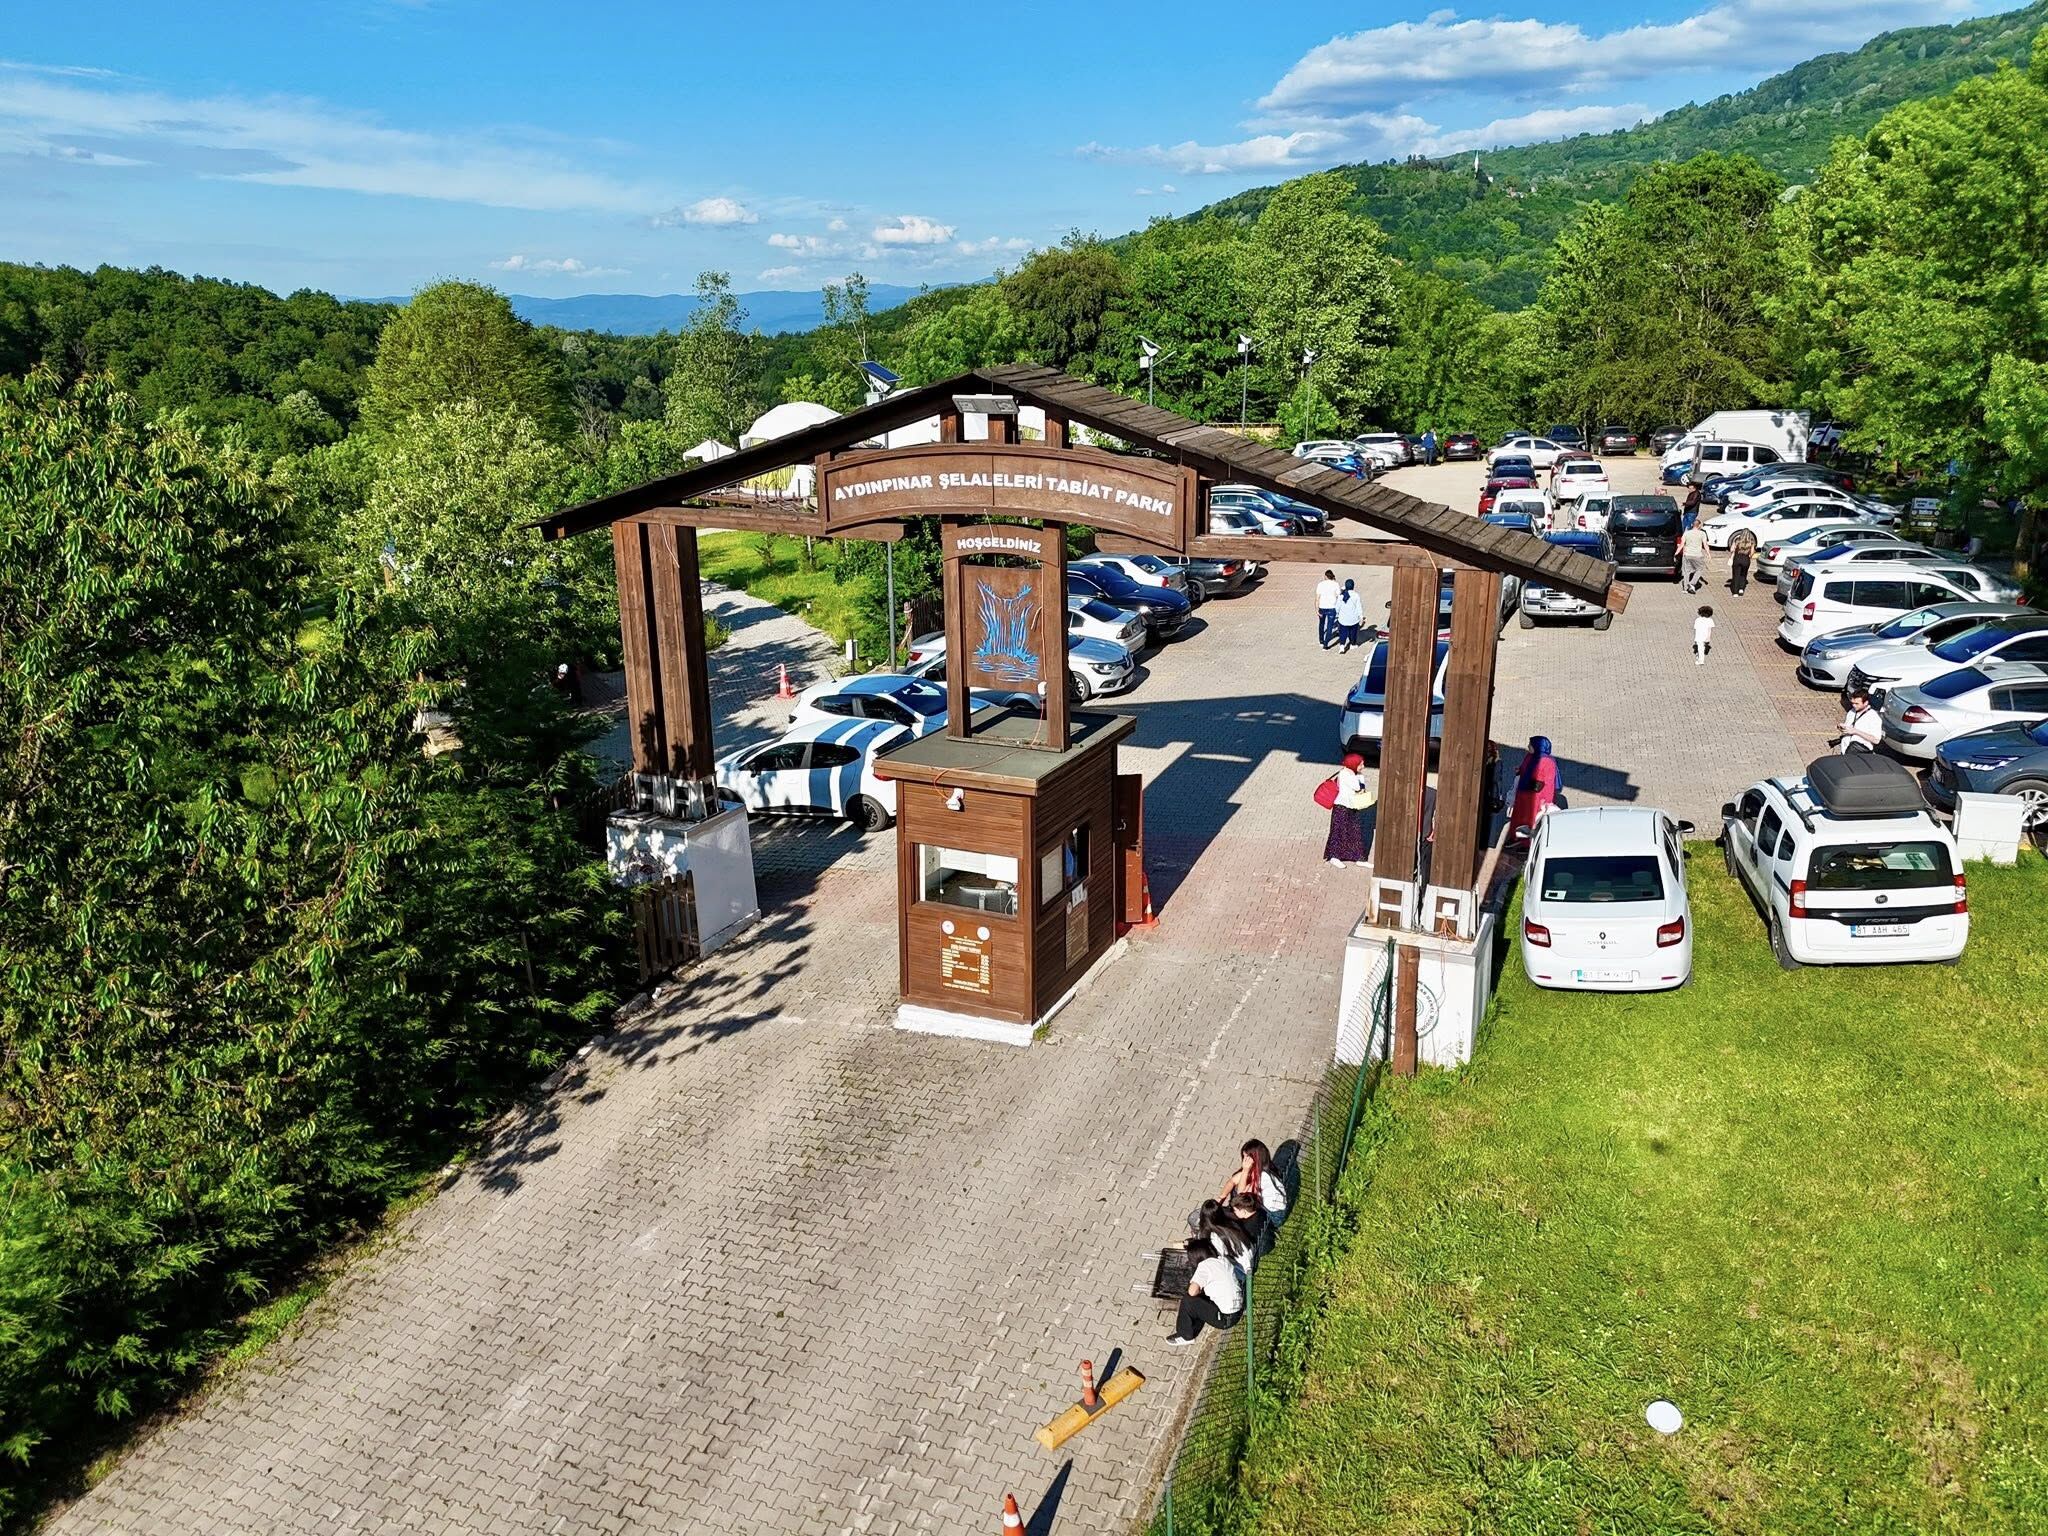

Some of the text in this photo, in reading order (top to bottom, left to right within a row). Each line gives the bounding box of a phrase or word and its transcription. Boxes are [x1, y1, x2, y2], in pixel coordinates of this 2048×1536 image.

[835, 473, 1173, 516] AYDINPINAR ŞELALELERİ TABİAT PARKI
[956, 536, 1042, 554] HOŞGELDİNİZ
